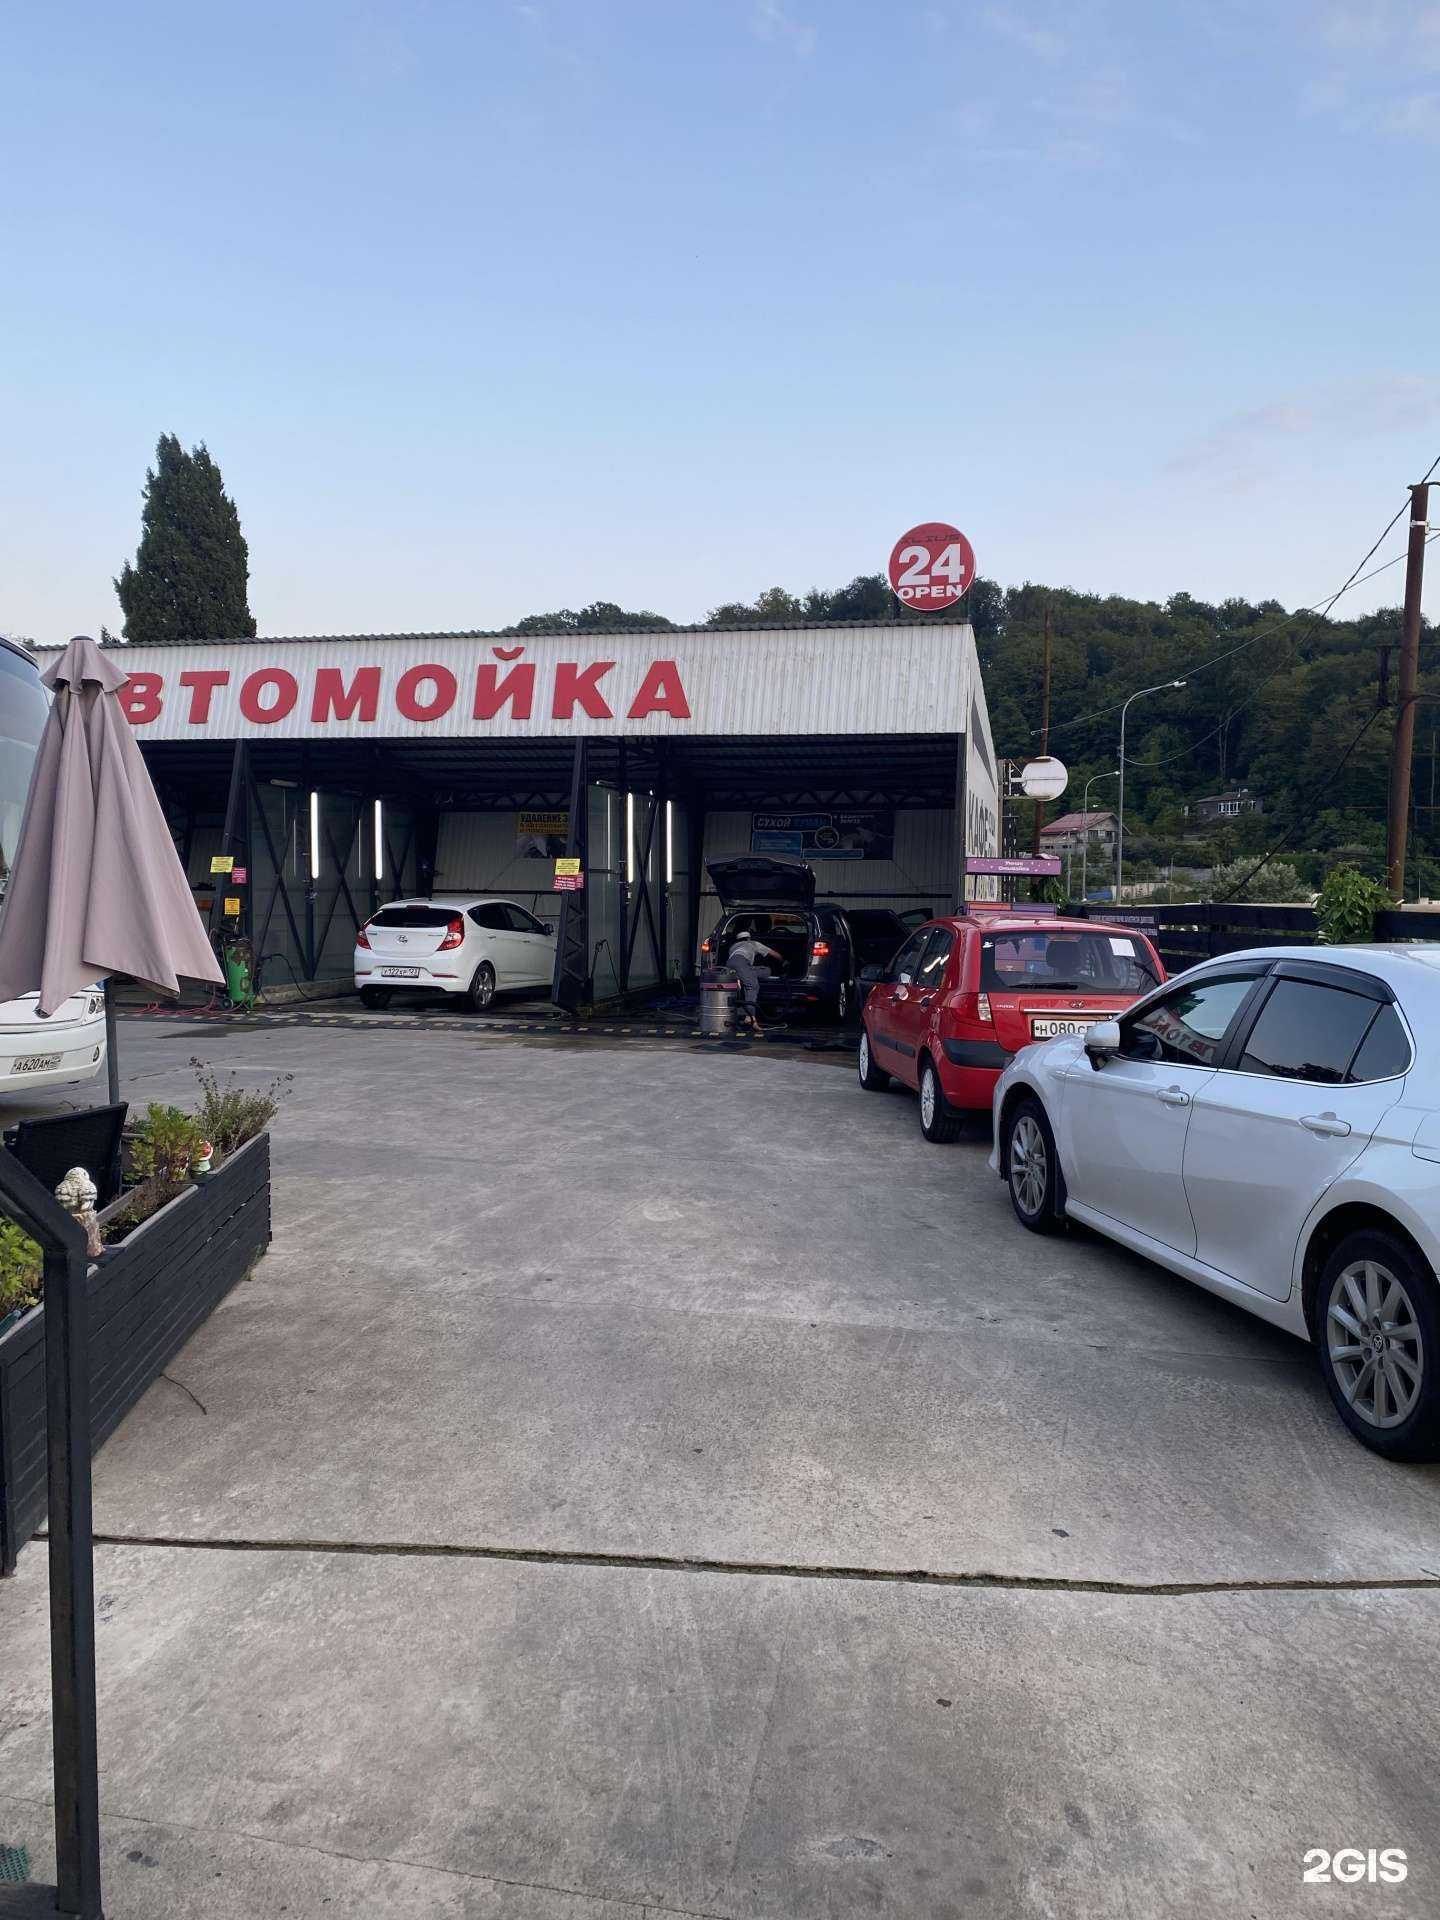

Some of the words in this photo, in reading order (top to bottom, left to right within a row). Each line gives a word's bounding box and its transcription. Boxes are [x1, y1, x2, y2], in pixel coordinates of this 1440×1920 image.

[898, 543, 965, 586] 24
[897, 585, 963, 600] OPEN
[117, 647, 691, 725] ВТОМОЙКА
